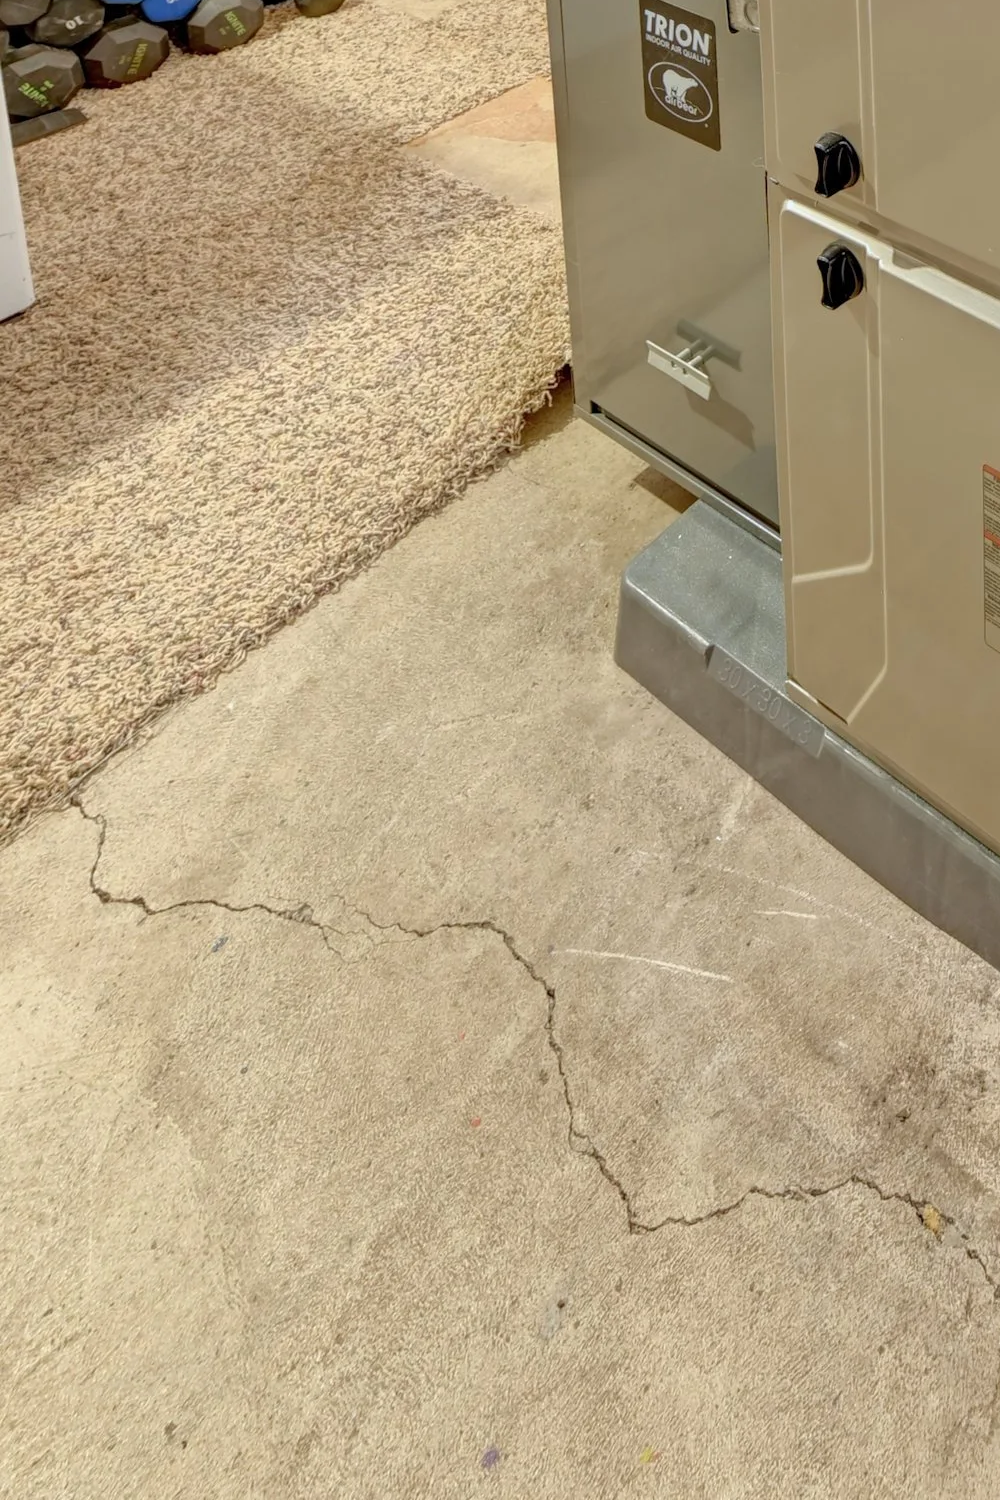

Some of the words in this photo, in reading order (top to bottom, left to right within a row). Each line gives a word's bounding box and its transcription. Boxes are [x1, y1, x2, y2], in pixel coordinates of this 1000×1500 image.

[65, 16, 85, 30] 10
[224, 11, 246, 36] IGNITE
[644, 8, 710, 56] TRION
[127, 43, 148, 74] IGNITE
[645, 32, 670, 50] INDOOR
[670, 44, 682, 55] AIR
[683, 48, 711, 67] QUALITY
